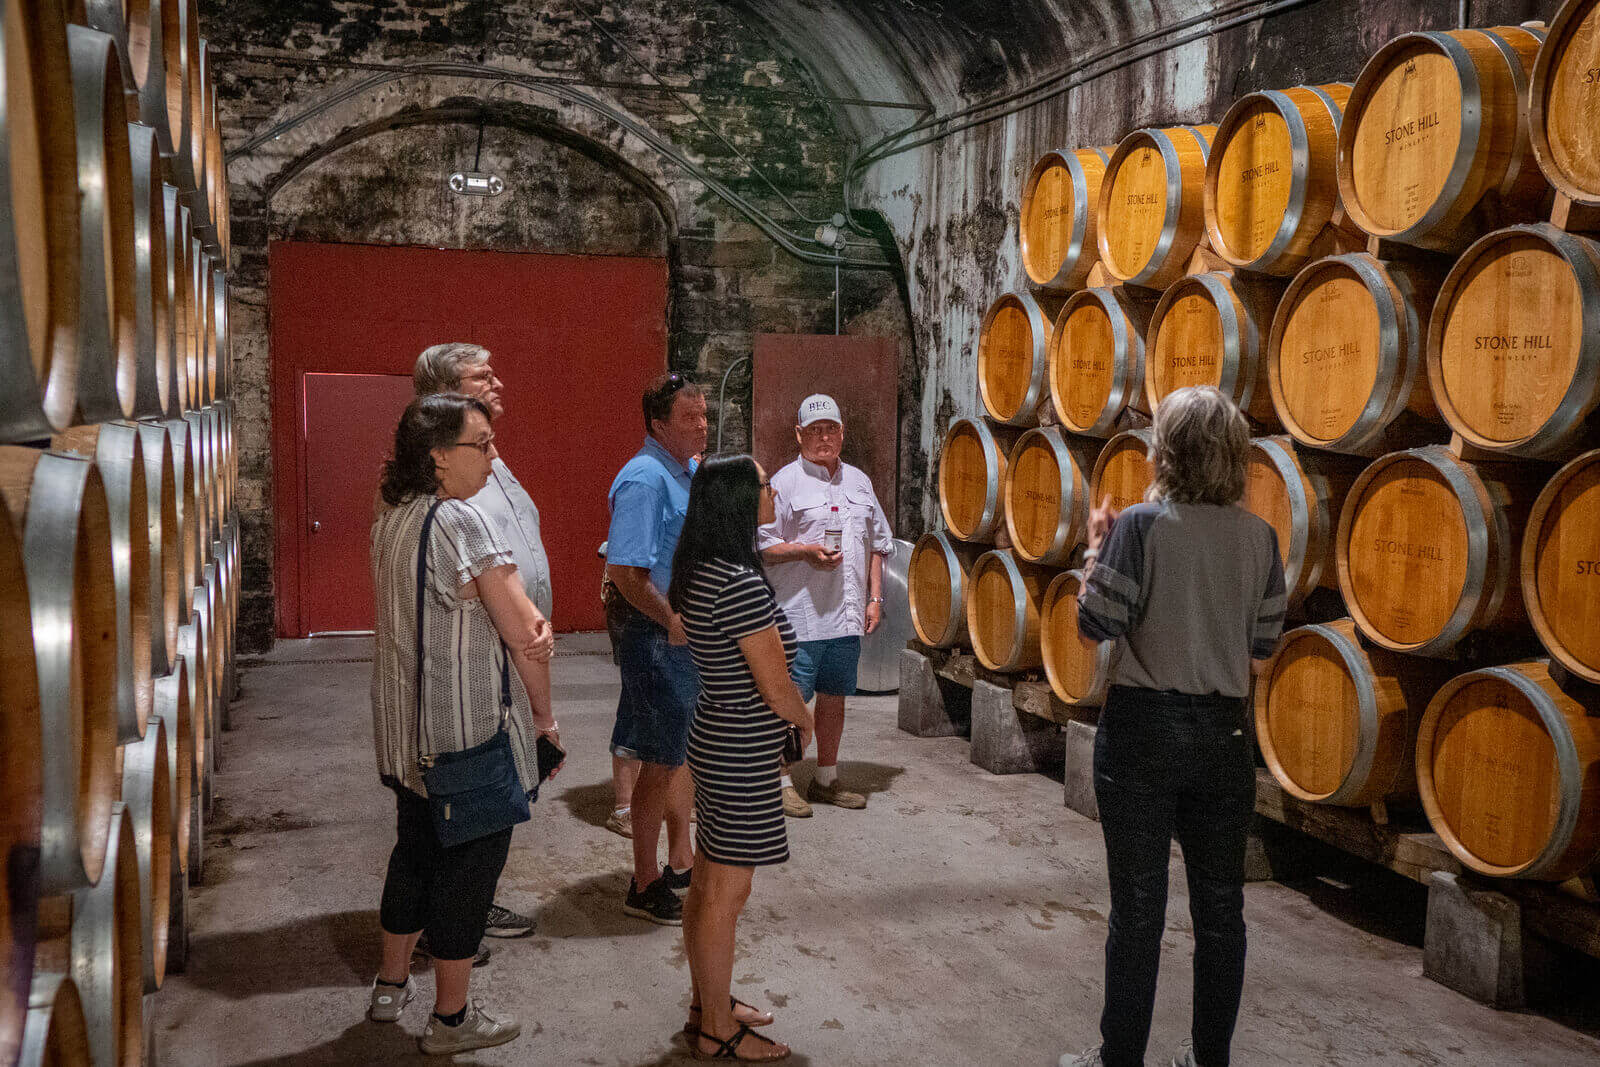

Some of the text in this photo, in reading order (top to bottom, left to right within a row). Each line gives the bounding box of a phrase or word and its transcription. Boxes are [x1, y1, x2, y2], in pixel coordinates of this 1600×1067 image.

[1385, 112, 1440, 145] STONE HILL
[1241, 160, 1280, 183] STONE HILL
[1127, 193, 1158, 205] STONE HILL
[1474, 335, 1552, 350] STONE HILL
[1303, 342, 1360, 364] STONE HILL
[1073, 360, 1105, 370] STONE HILL
[1172, 355, 1216, 367] STONE HILL
[809, 401, 831, 411] BEC
[1374, 539, 1443, 561] STONE HILL
